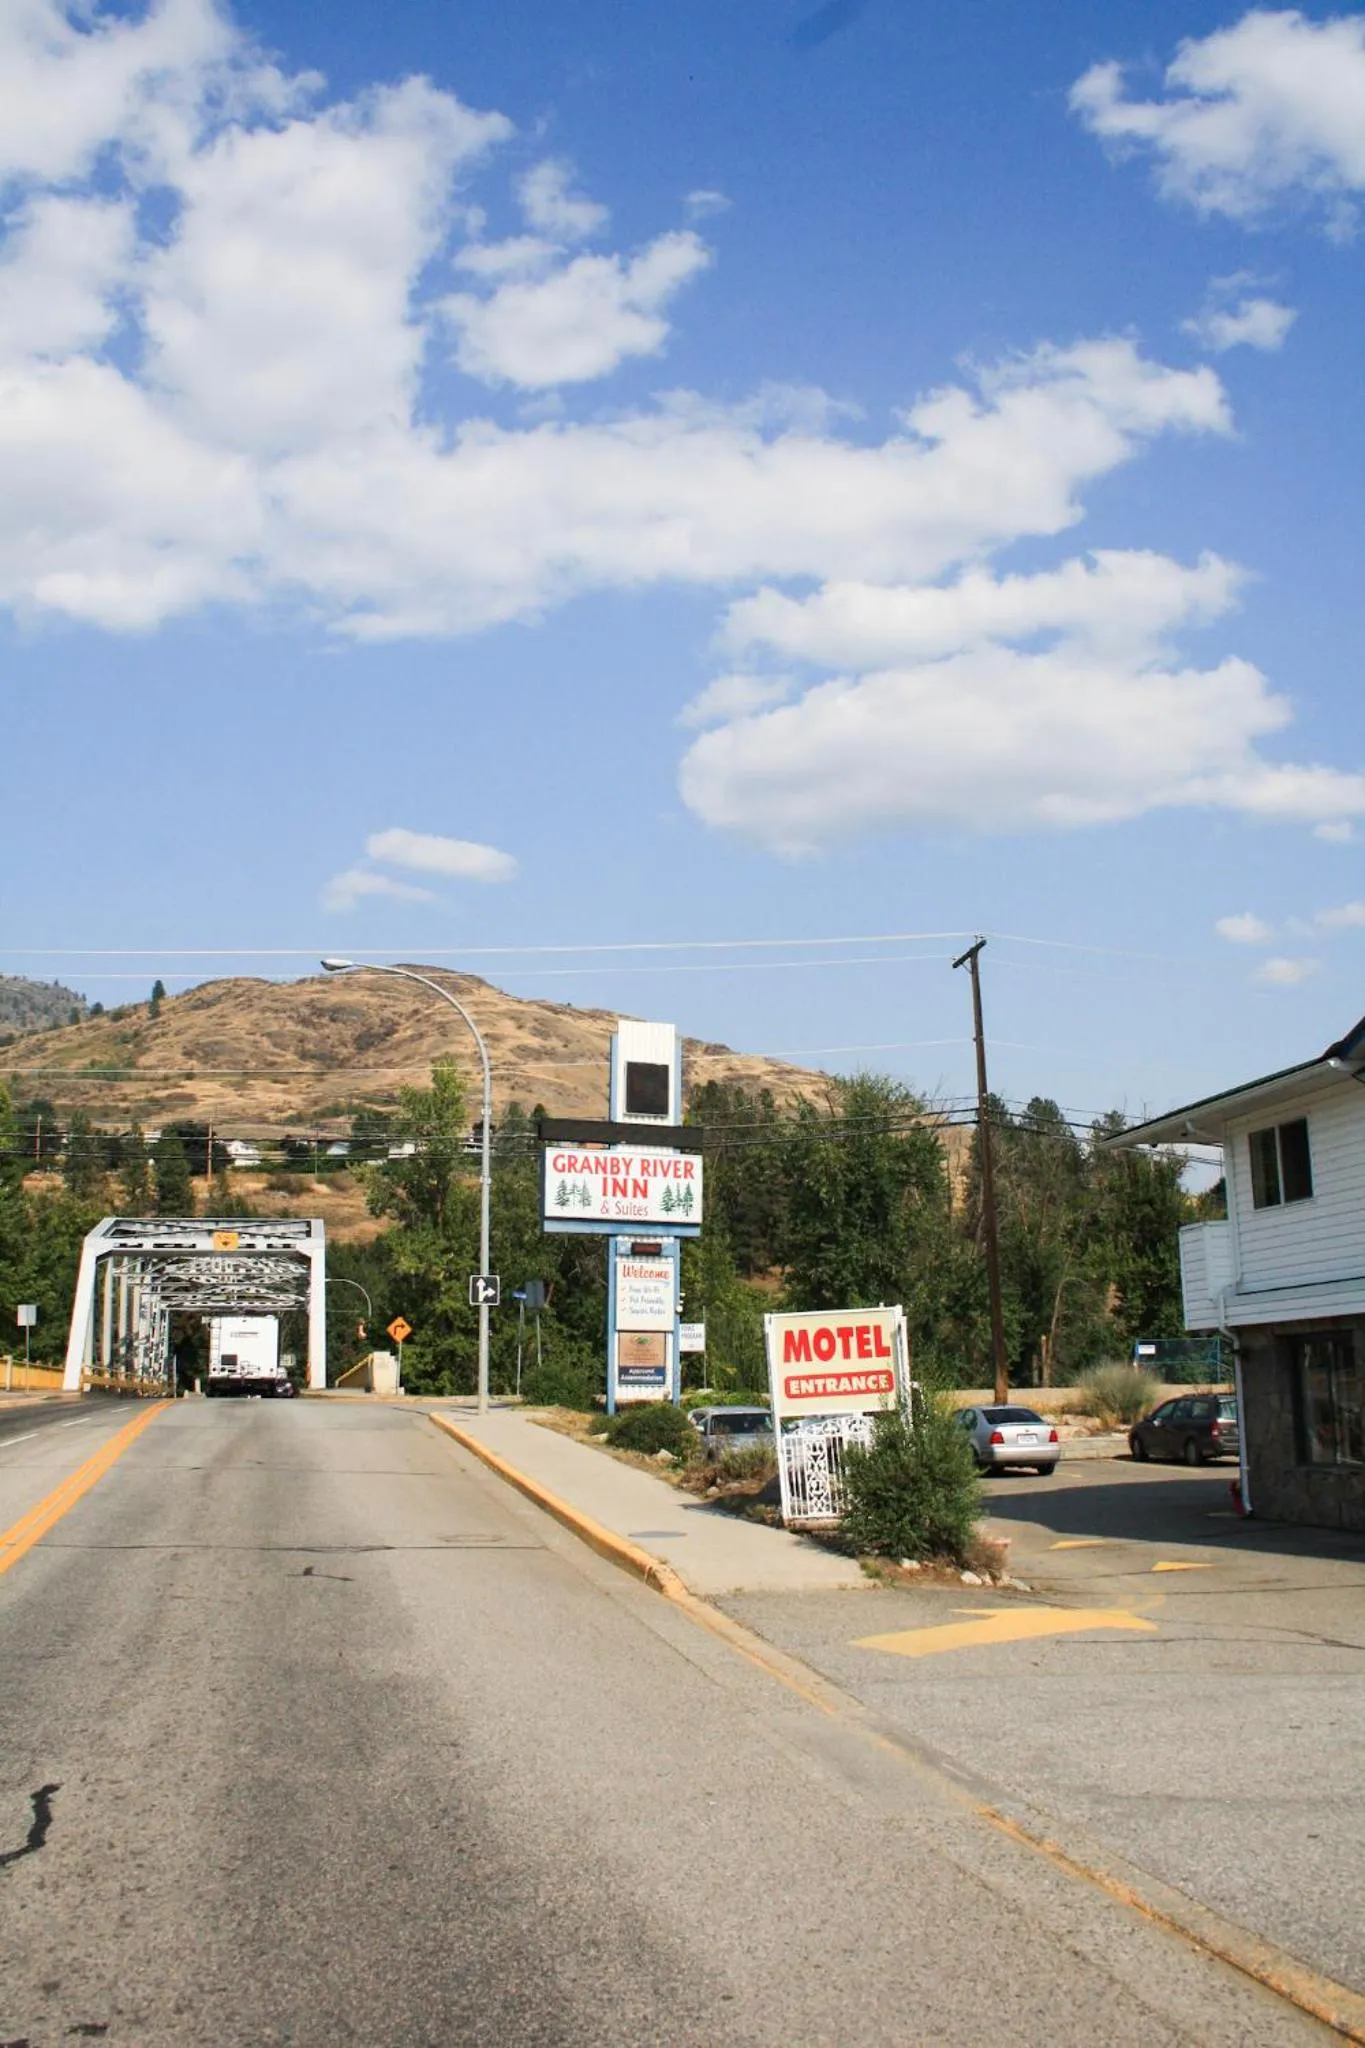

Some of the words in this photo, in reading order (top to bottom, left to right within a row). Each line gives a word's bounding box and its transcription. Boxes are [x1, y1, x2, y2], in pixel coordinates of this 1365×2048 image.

[552, 1154, 634, 1176] GRANBY
[640, 1158, 695, 1180] RIVER
[602, 1177, 648, 1199] INN
[600, 1200, 609, 1214] &
[615, 1200, 648, 1216] Suites
[623, 1264, 670, 1280] Welcome
[783, 1325, 891, 1363] MOTEL
[789, 1374, 889, 1395] ENTRANCE
